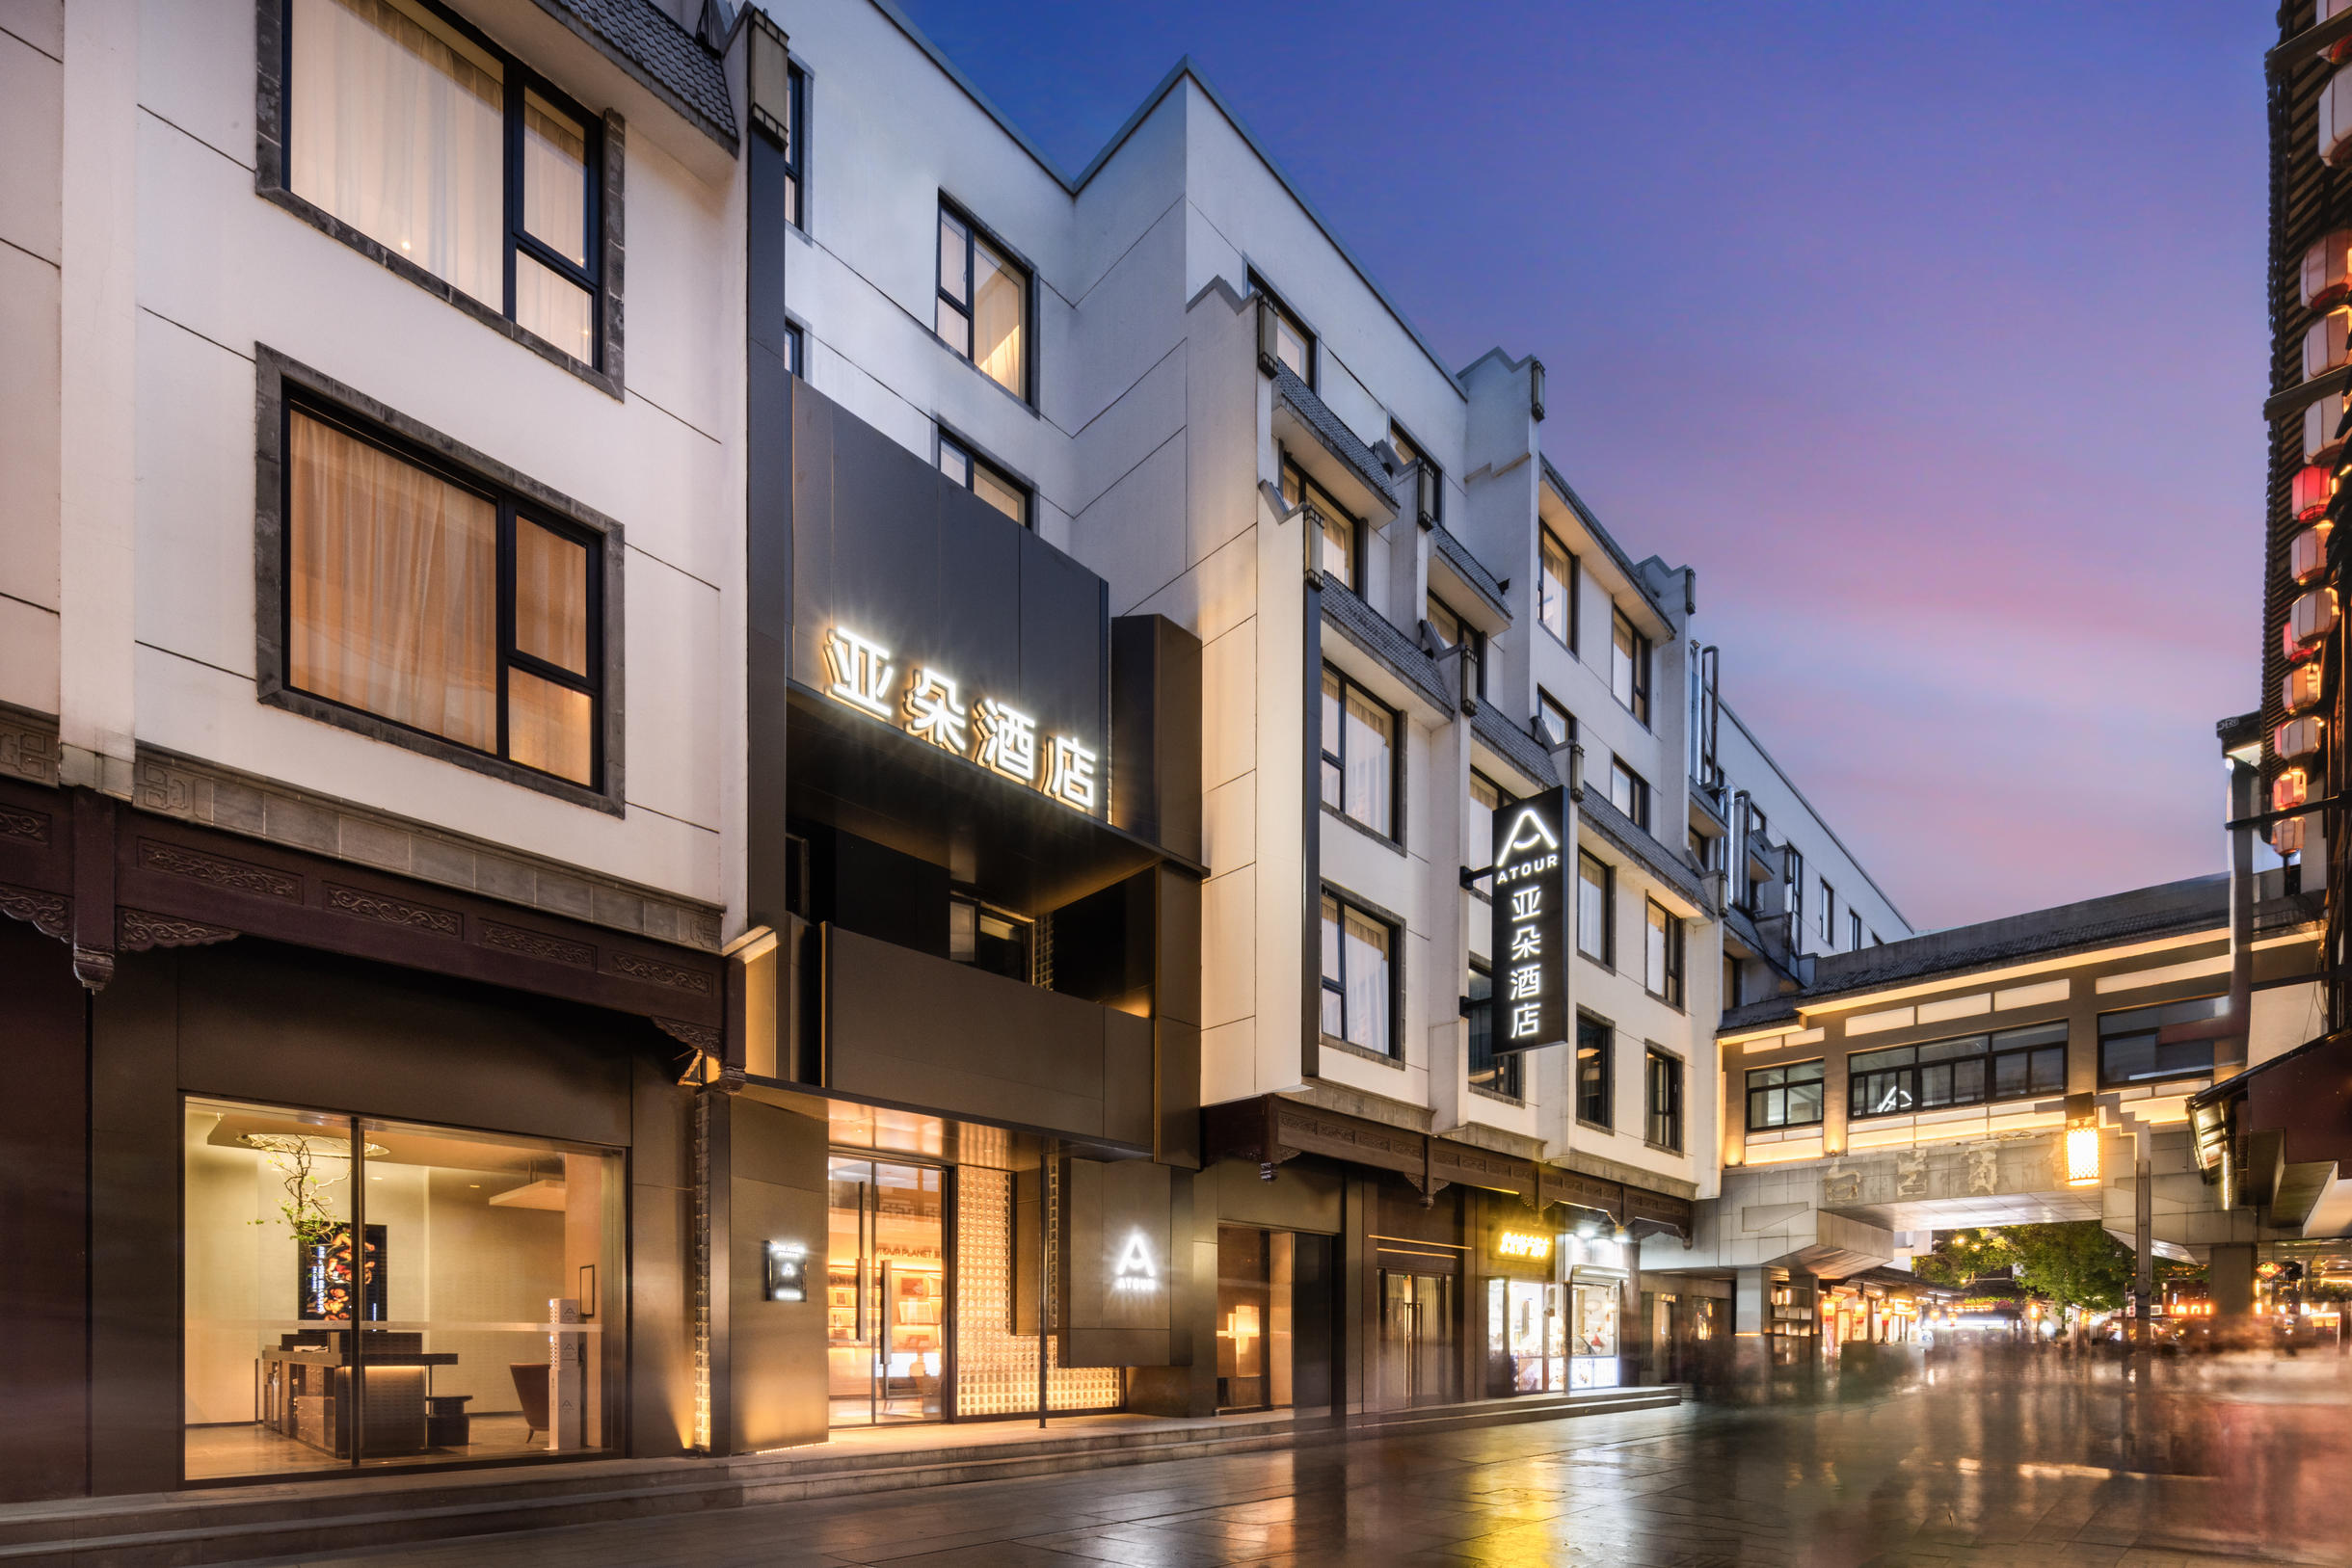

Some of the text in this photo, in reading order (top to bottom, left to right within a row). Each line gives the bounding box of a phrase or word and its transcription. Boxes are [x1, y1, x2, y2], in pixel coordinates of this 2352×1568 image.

[826, 625, 1096, 810] 亚朵酒店
[1497, 854, 1559, 886] ATOUR
[1510, 885, 1542, 1040] 亚朵酒店
